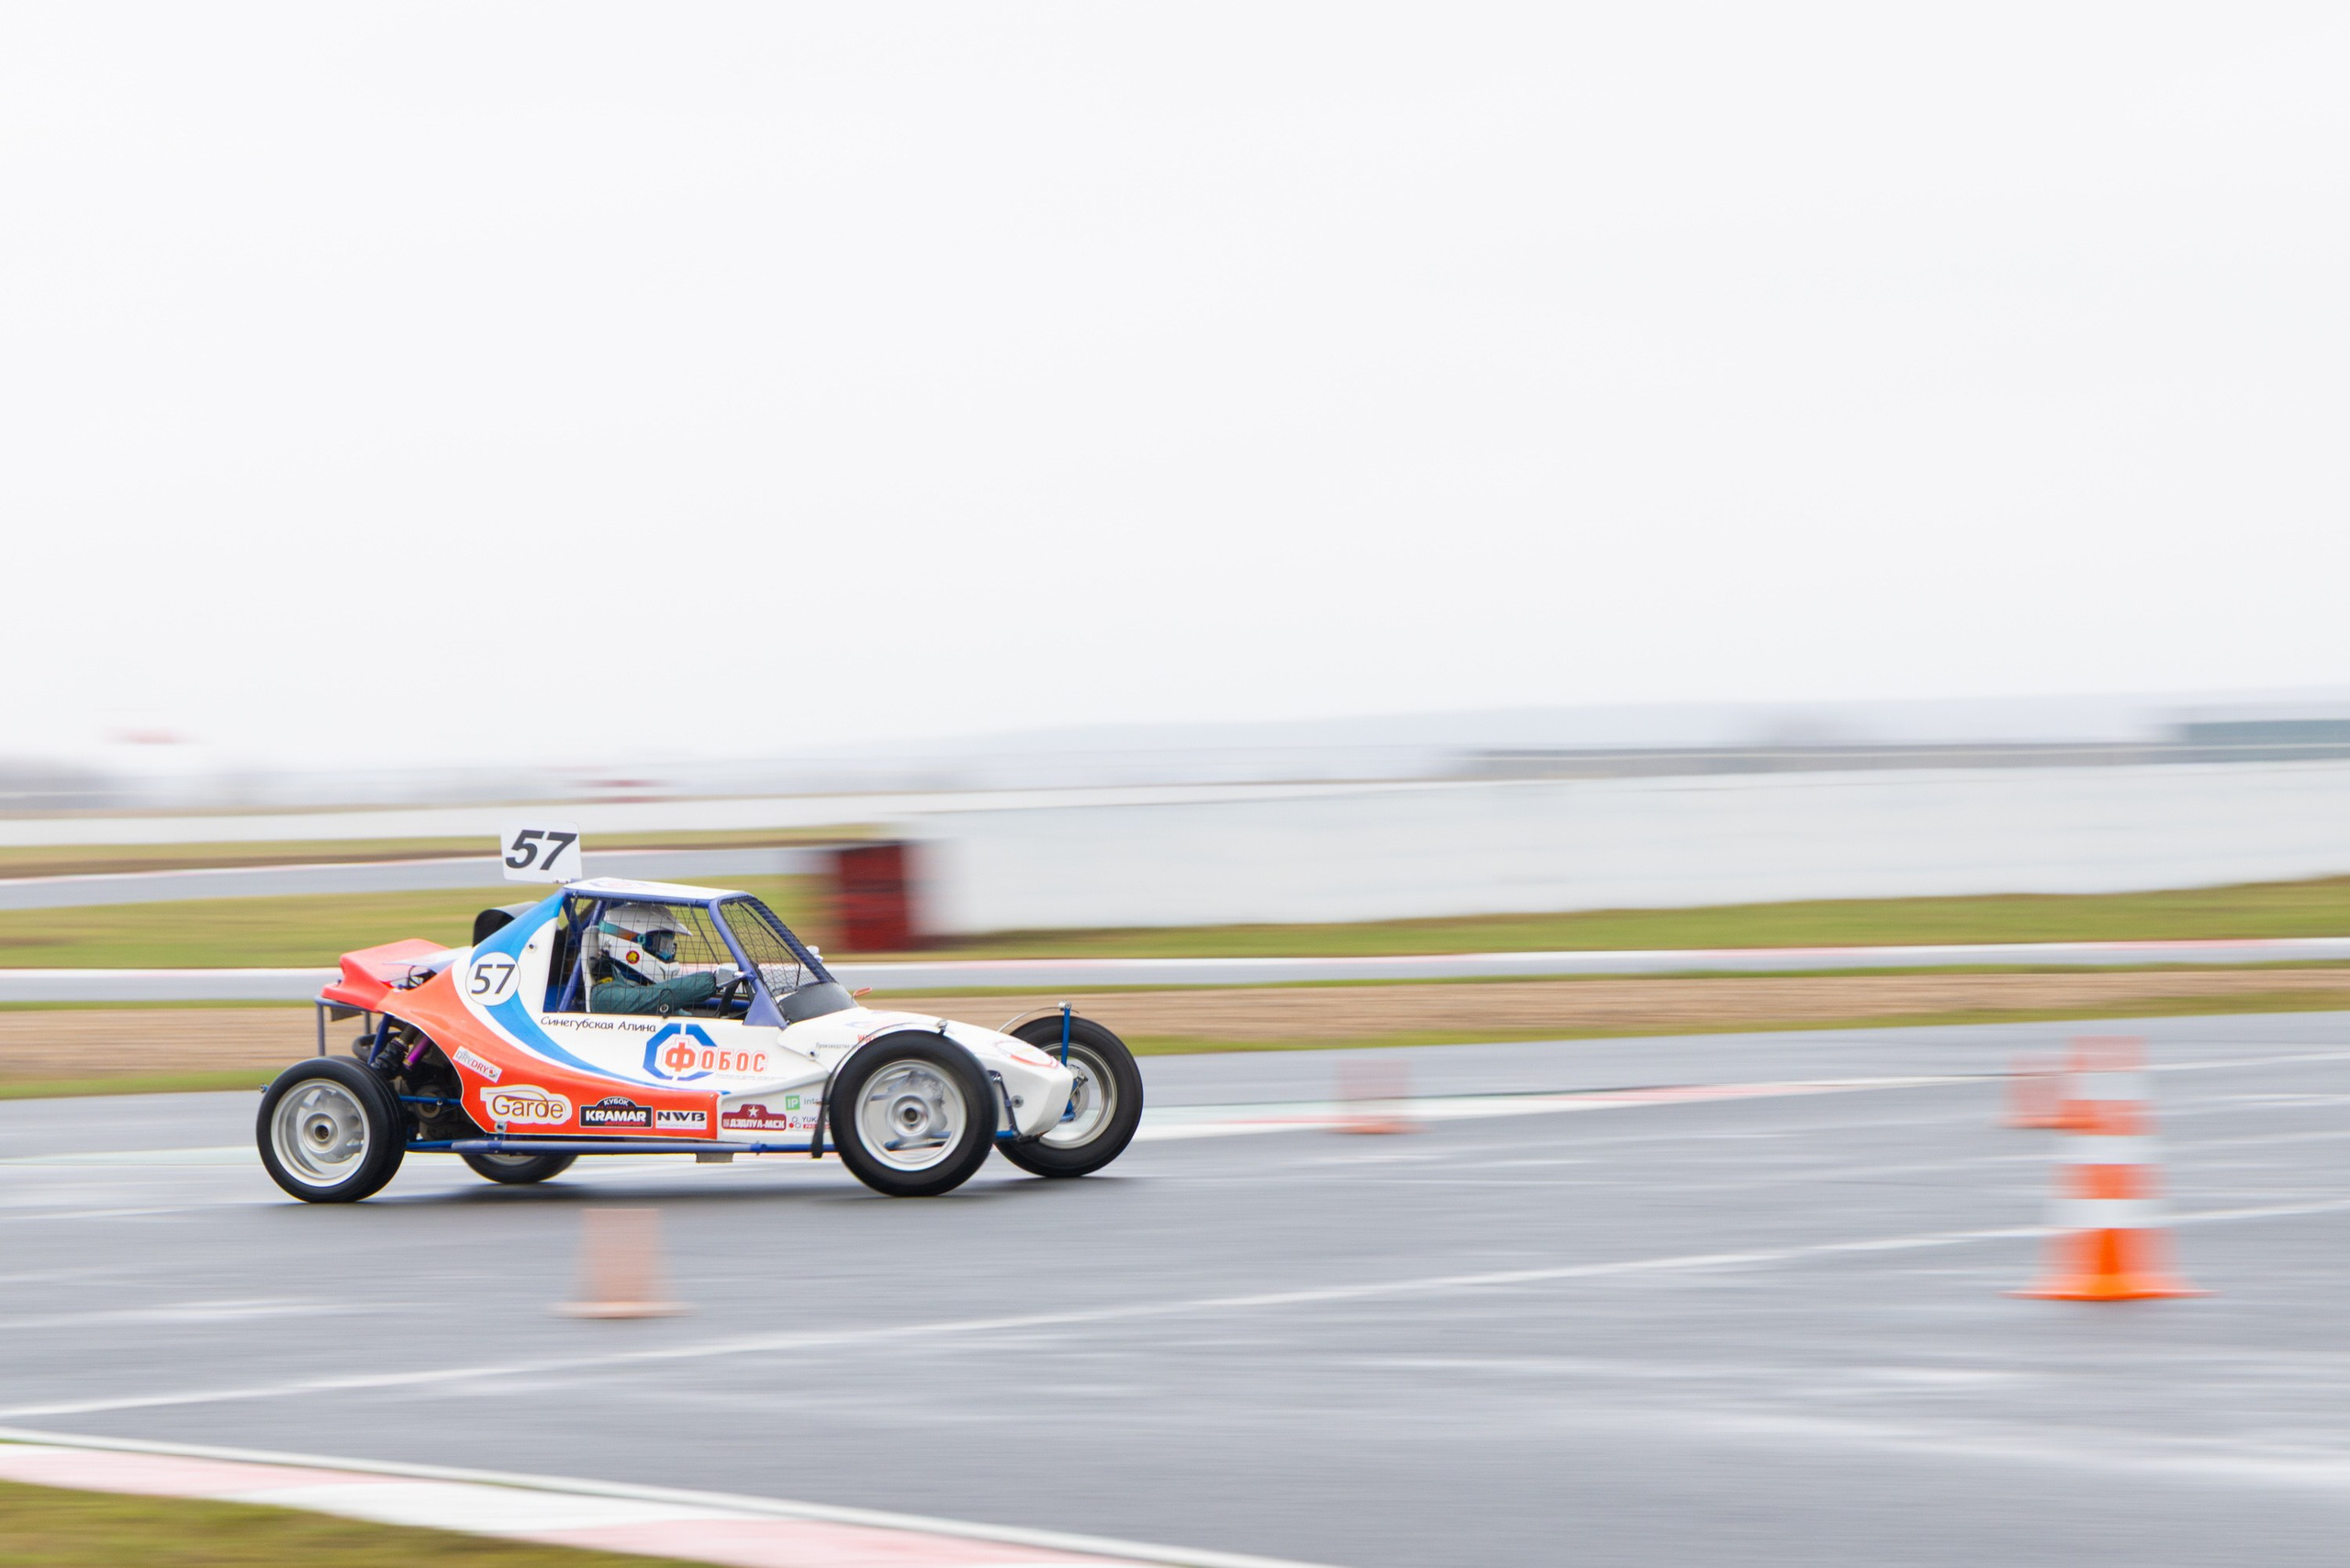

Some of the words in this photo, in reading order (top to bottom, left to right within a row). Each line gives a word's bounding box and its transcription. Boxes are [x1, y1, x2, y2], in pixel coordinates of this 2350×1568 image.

[506, 829, 577, 870] 57
[471, 964, 515, 994] 57
[541, 1015, 613, 1031] Синегубская
[618, 1021, 656, 1033] Алина
[665, 1042, 767, 1072] ФОБОС
[492, 1094, 564, 1119] Garde
[603, 1098, 629, 1106] КУБОК
[586, 1110, 646, 1122] KRAMAR
[657, 1112, 705, 1121] NWB
